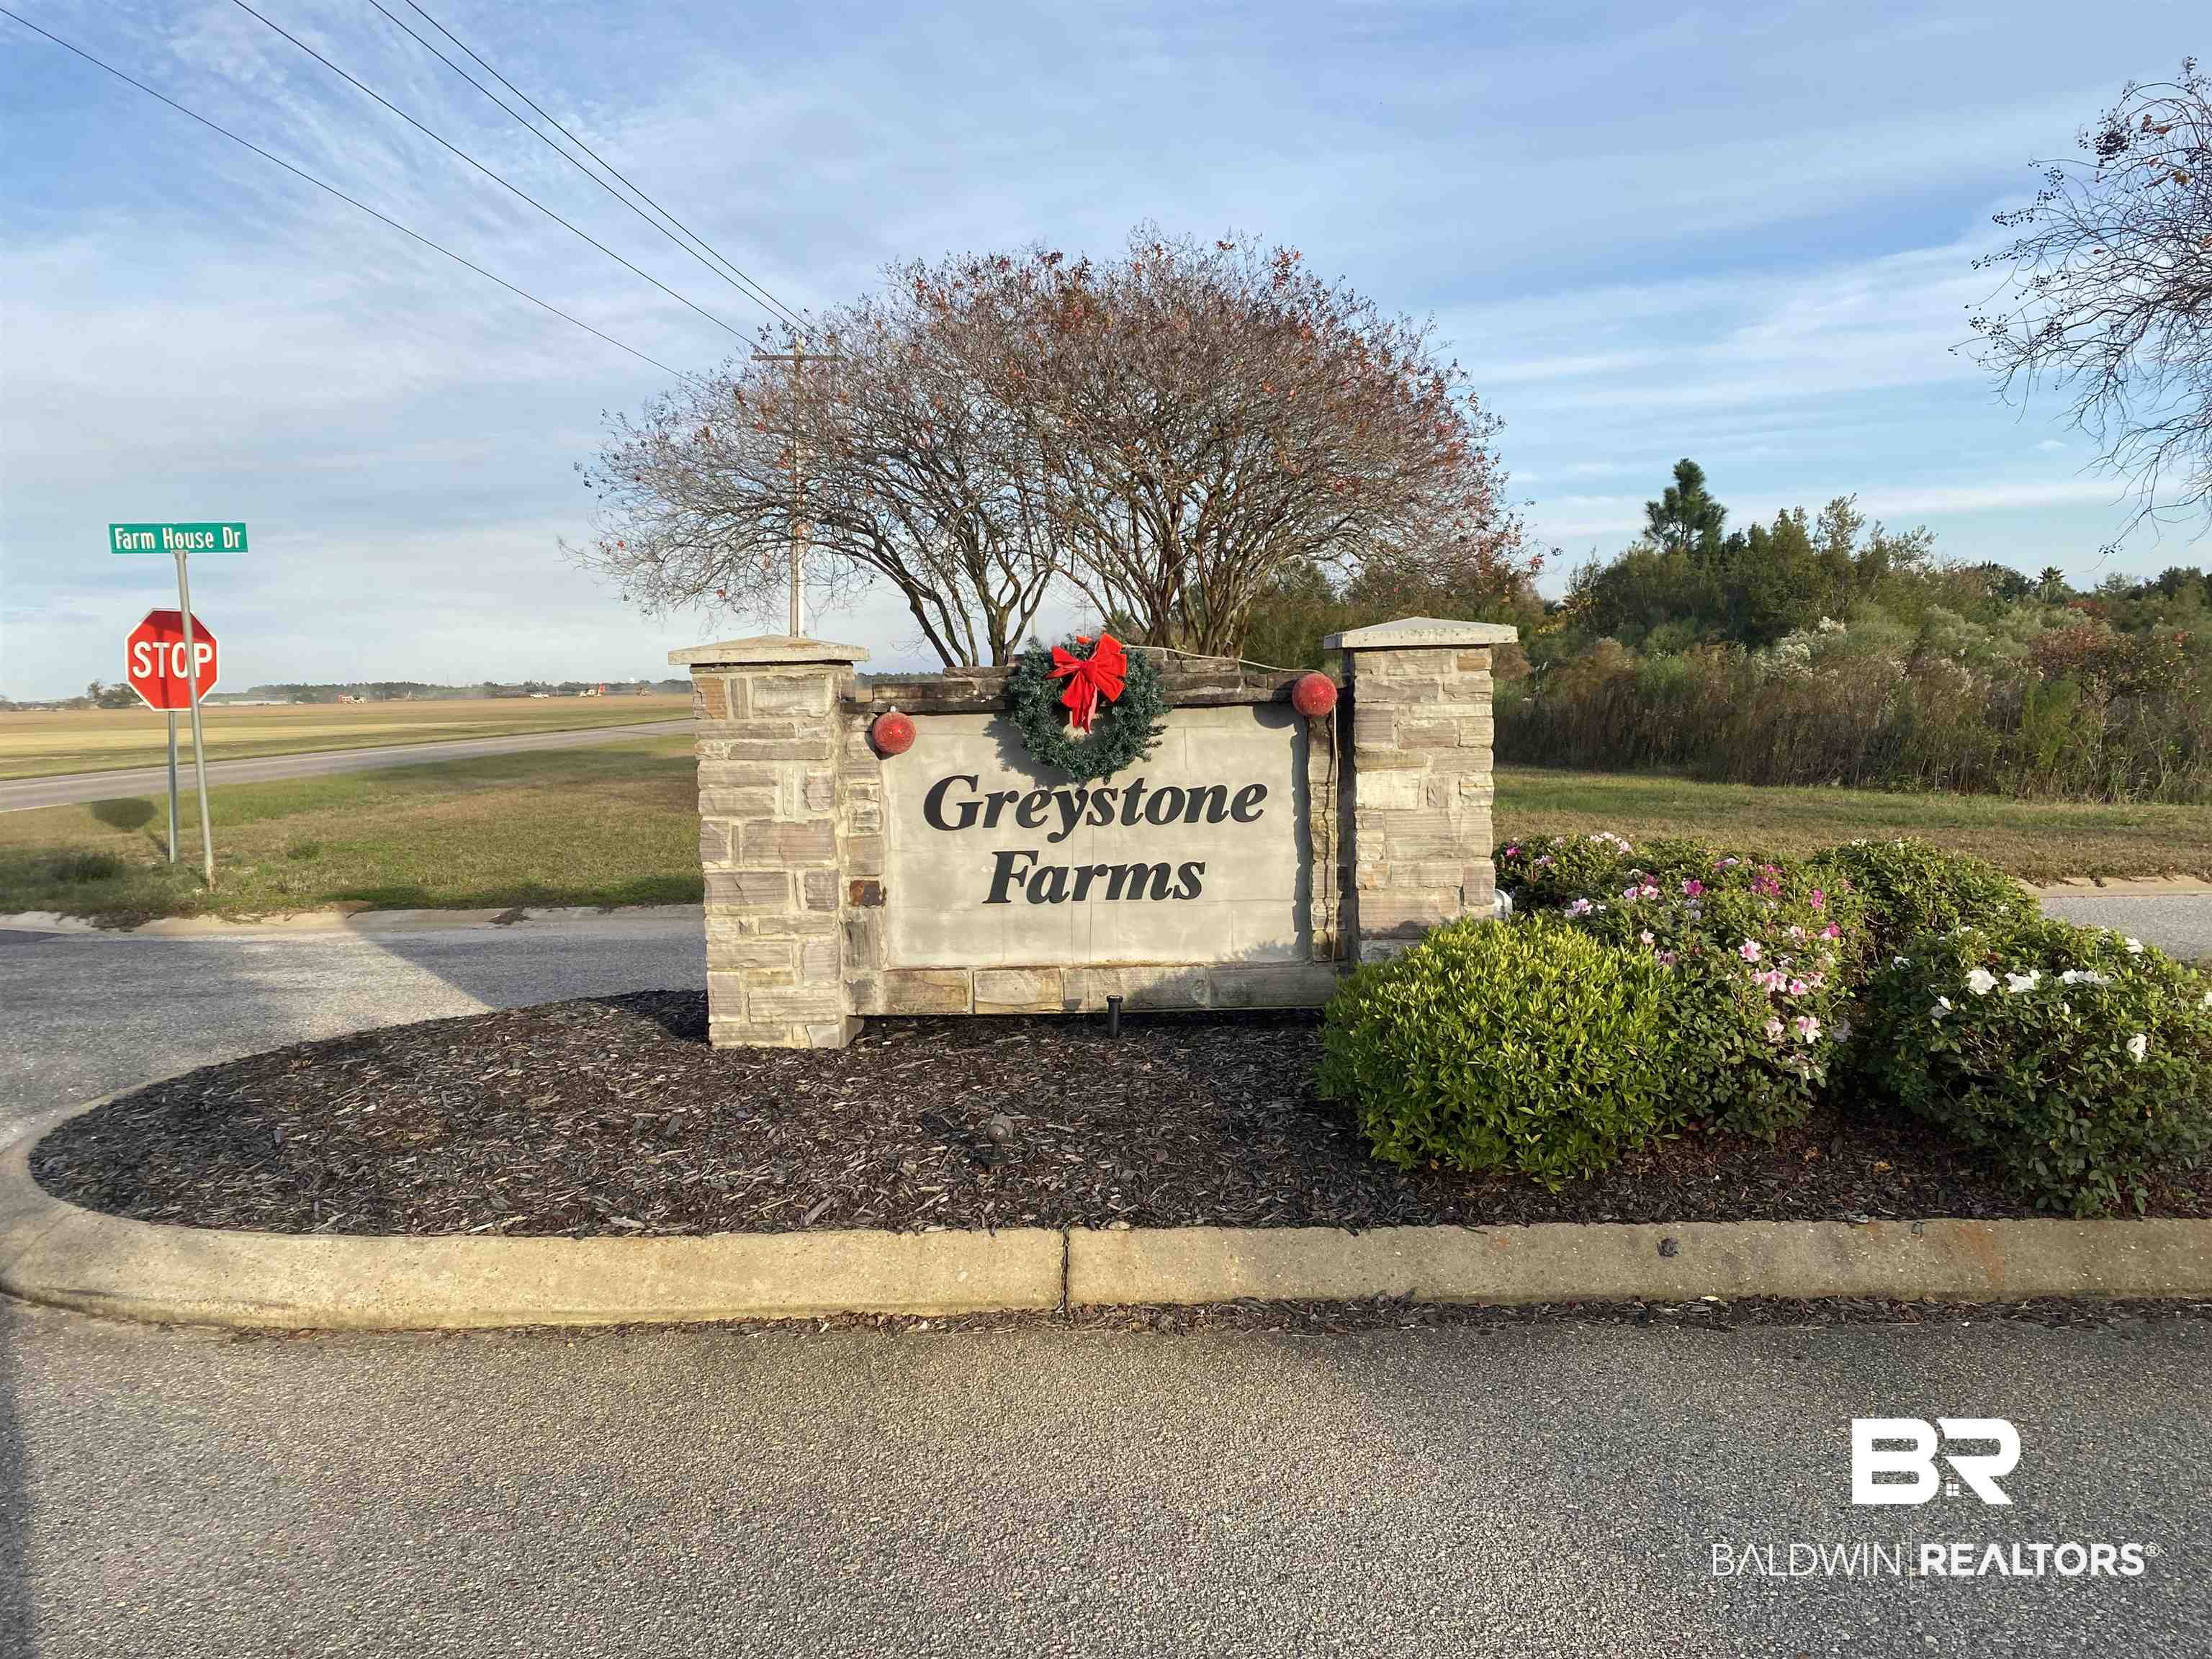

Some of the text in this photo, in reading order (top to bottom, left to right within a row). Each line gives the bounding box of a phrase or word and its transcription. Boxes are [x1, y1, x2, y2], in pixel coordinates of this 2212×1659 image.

[114, 526, 241, 549] Farm House Dr
[132, 641, 213, 678] STOP
[922, 774, 1268, 842] Greystone
[982, 850, 1206, 904] Farms
